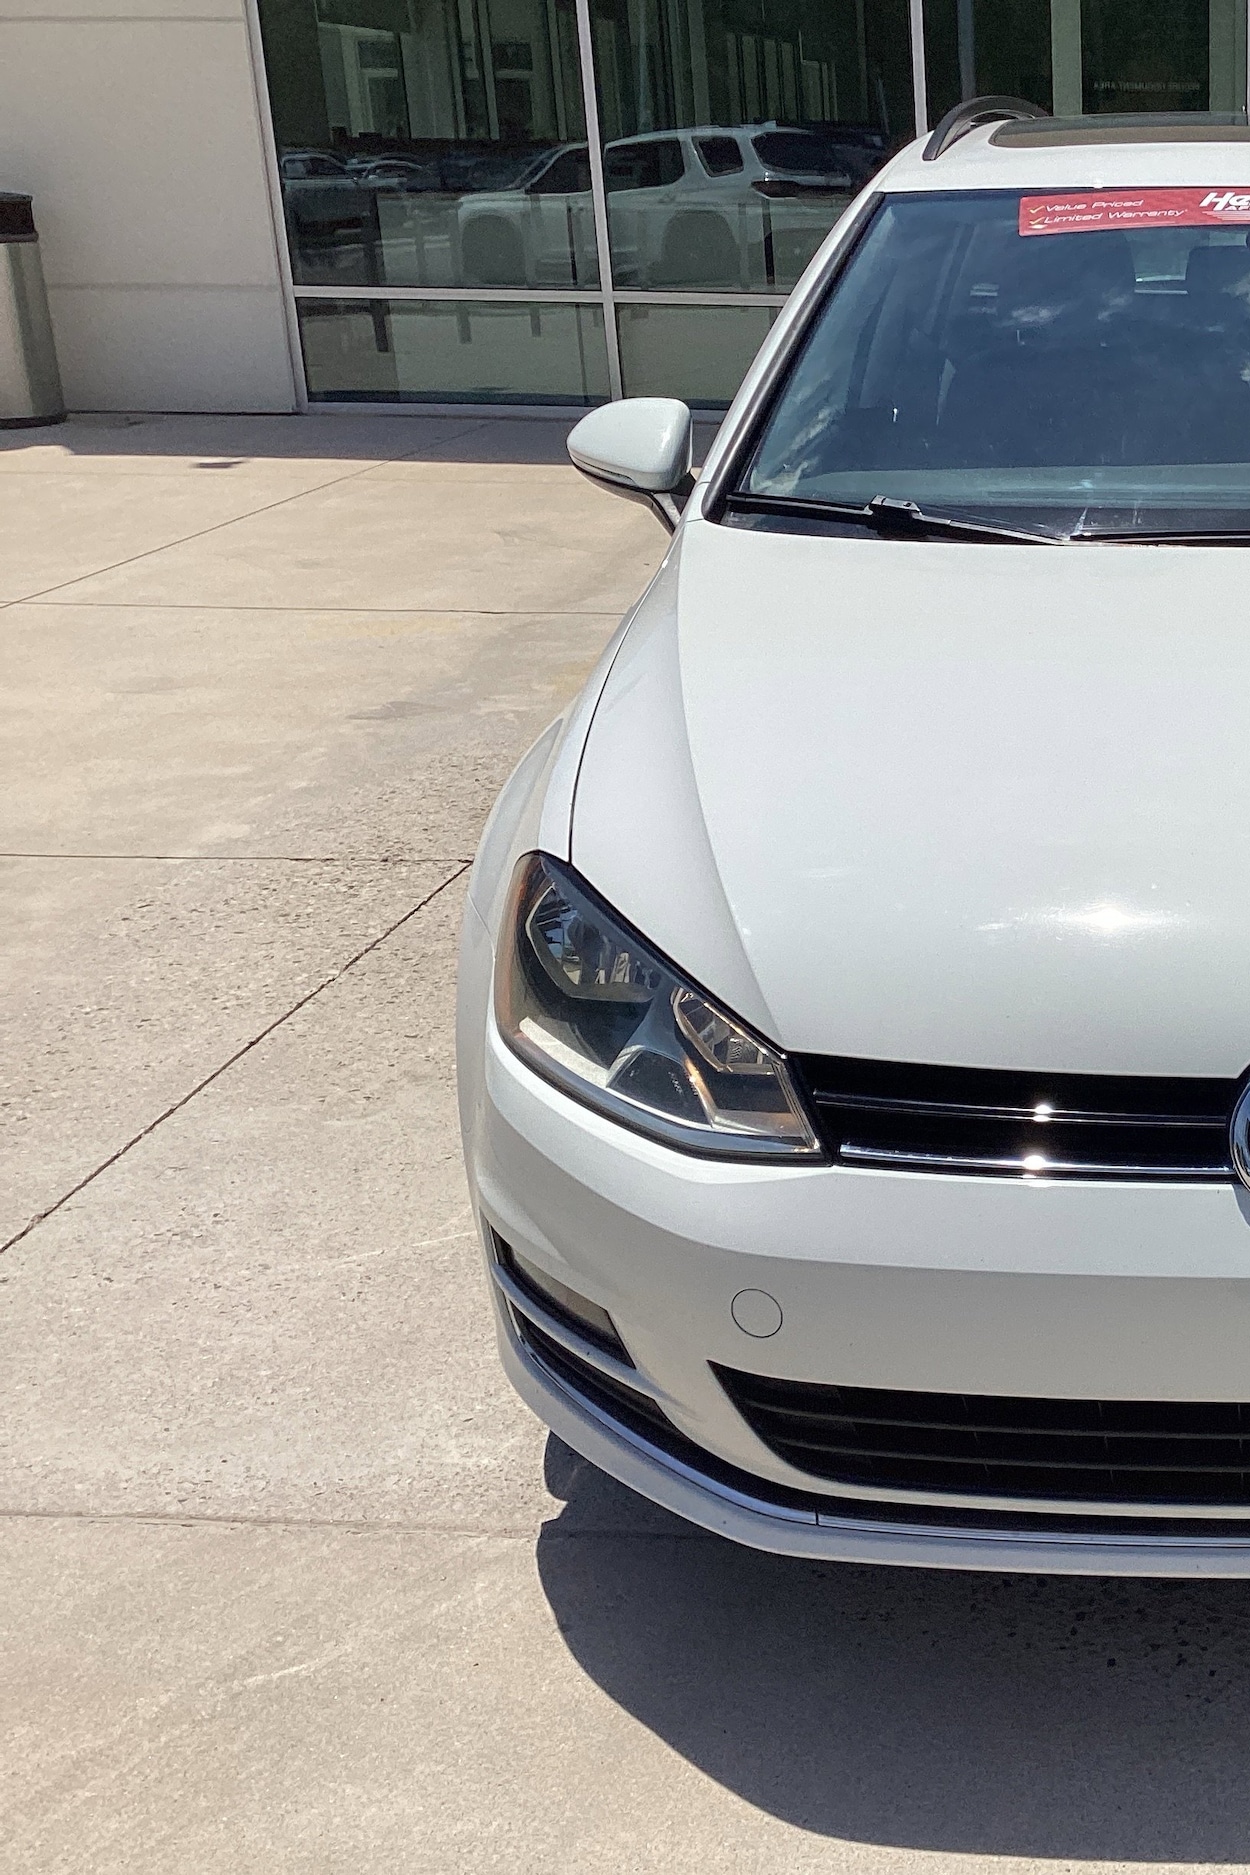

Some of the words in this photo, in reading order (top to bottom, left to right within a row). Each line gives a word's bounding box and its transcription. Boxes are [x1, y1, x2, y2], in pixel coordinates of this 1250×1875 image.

[1046, 203, 1087, 212] Value
[1092, 200, 1144, 209] Priced
[1044, 212, 1103, 224] Limited
